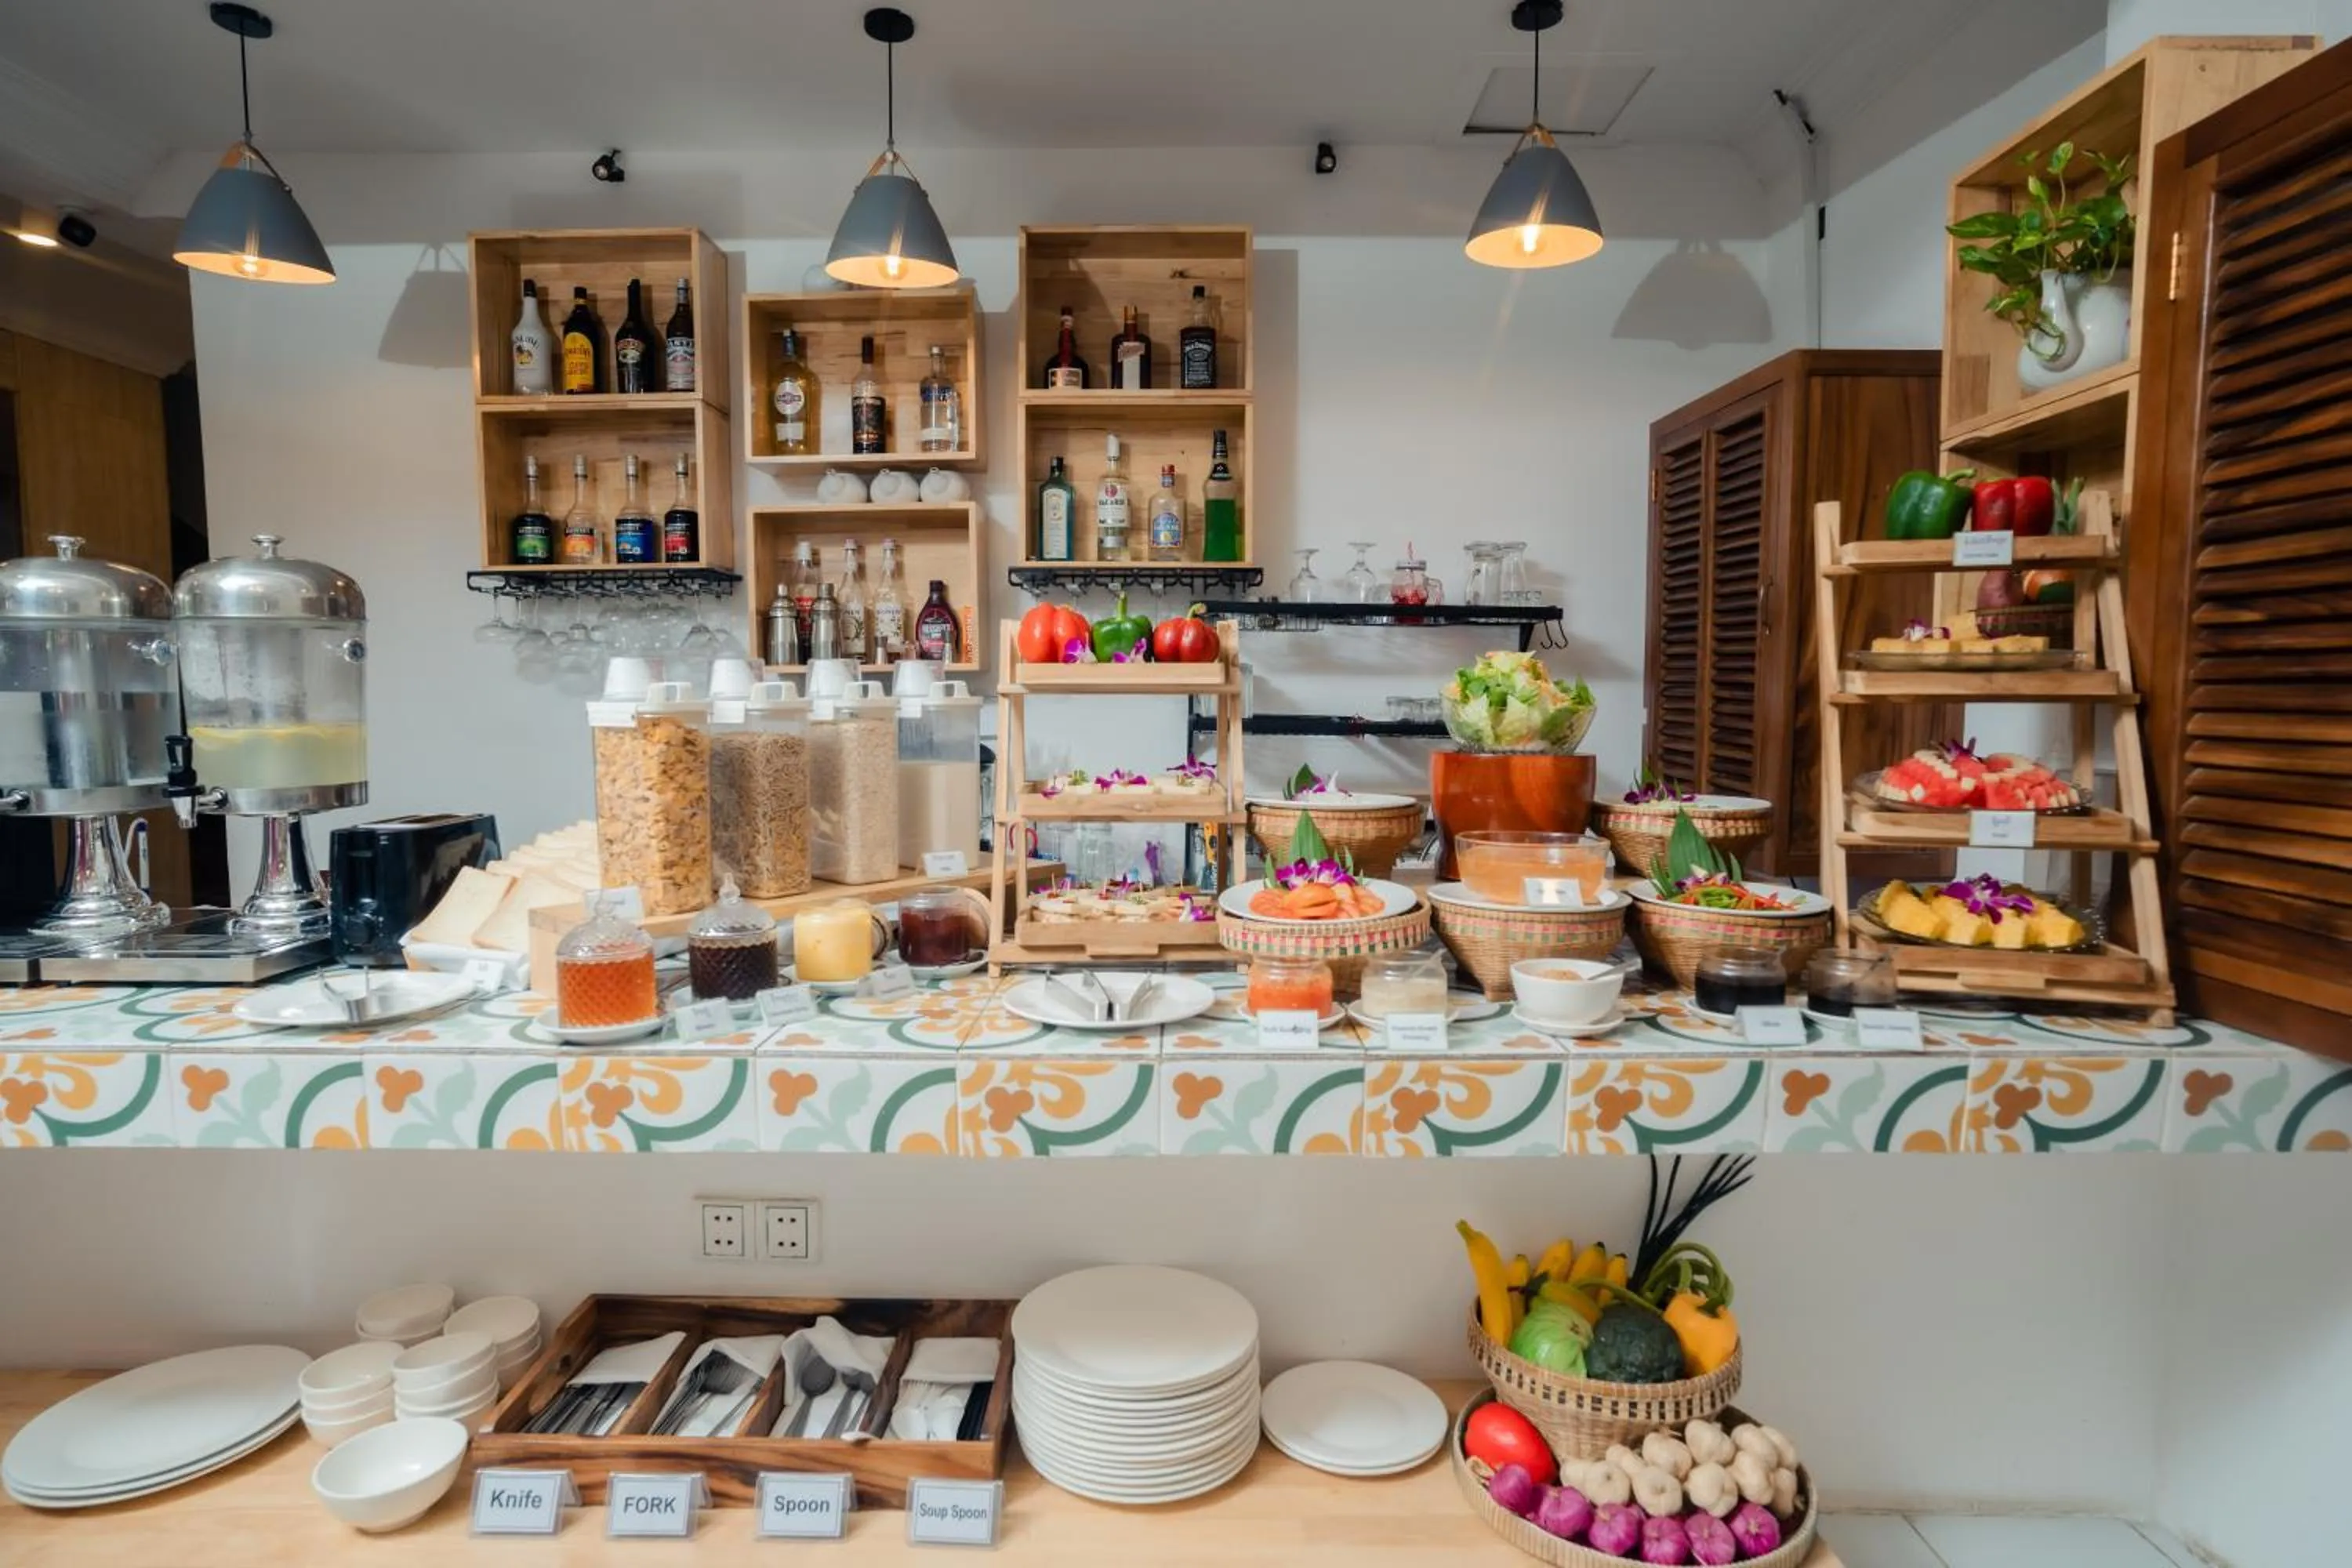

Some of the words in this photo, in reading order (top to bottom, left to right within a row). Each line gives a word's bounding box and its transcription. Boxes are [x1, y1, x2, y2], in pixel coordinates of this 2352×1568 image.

[490, 1489, 542, 1509] Knife
[623, 1496, 677, 1514] FORK
[773, 1495, 830, 1515] Spoon
[920, 1502, 947, 1521] Soup
[951, 1504, 987, 1521] Spoon
